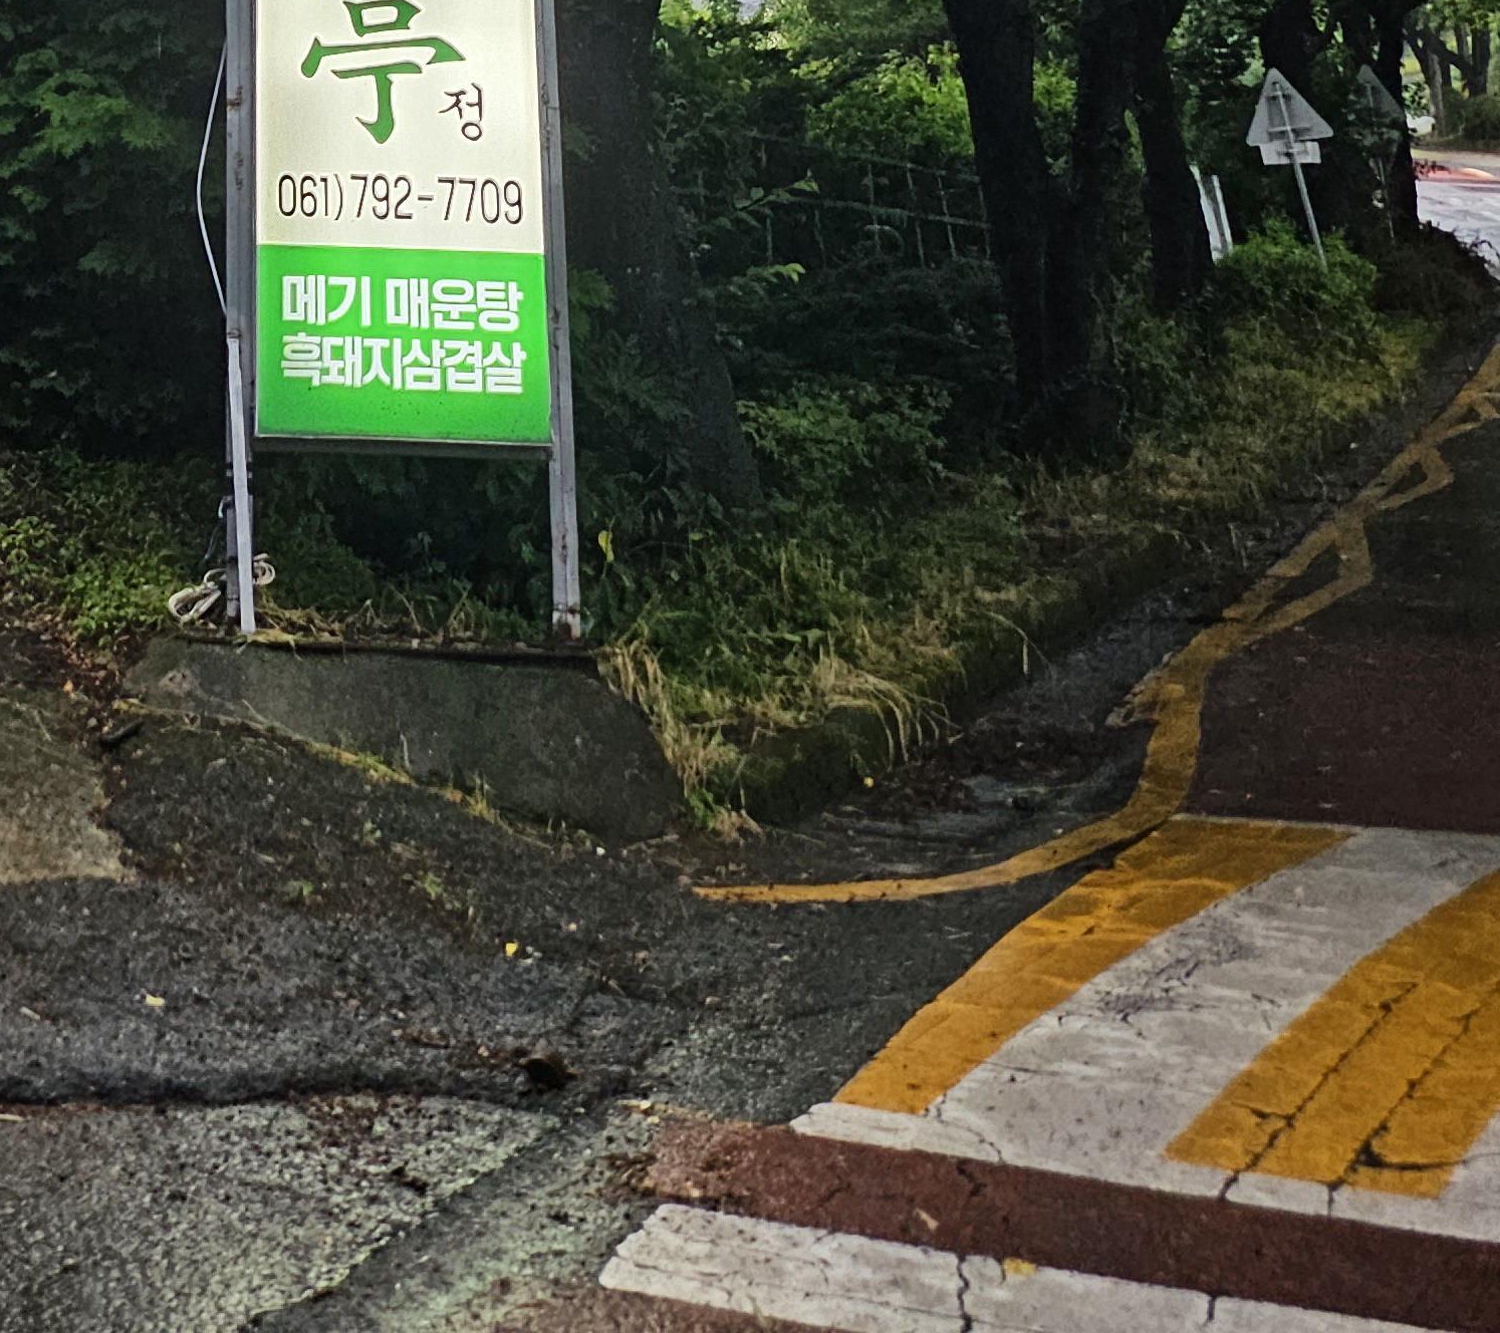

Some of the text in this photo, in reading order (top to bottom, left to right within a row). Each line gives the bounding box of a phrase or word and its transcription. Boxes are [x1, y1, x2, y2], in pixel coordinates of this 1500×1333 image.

[277, 173, 524, 225] 061)792-7709
[281, 274, 524, 331] 메기 매운탕
[280, 331, 527, 395] 흑돼지삼겹살
